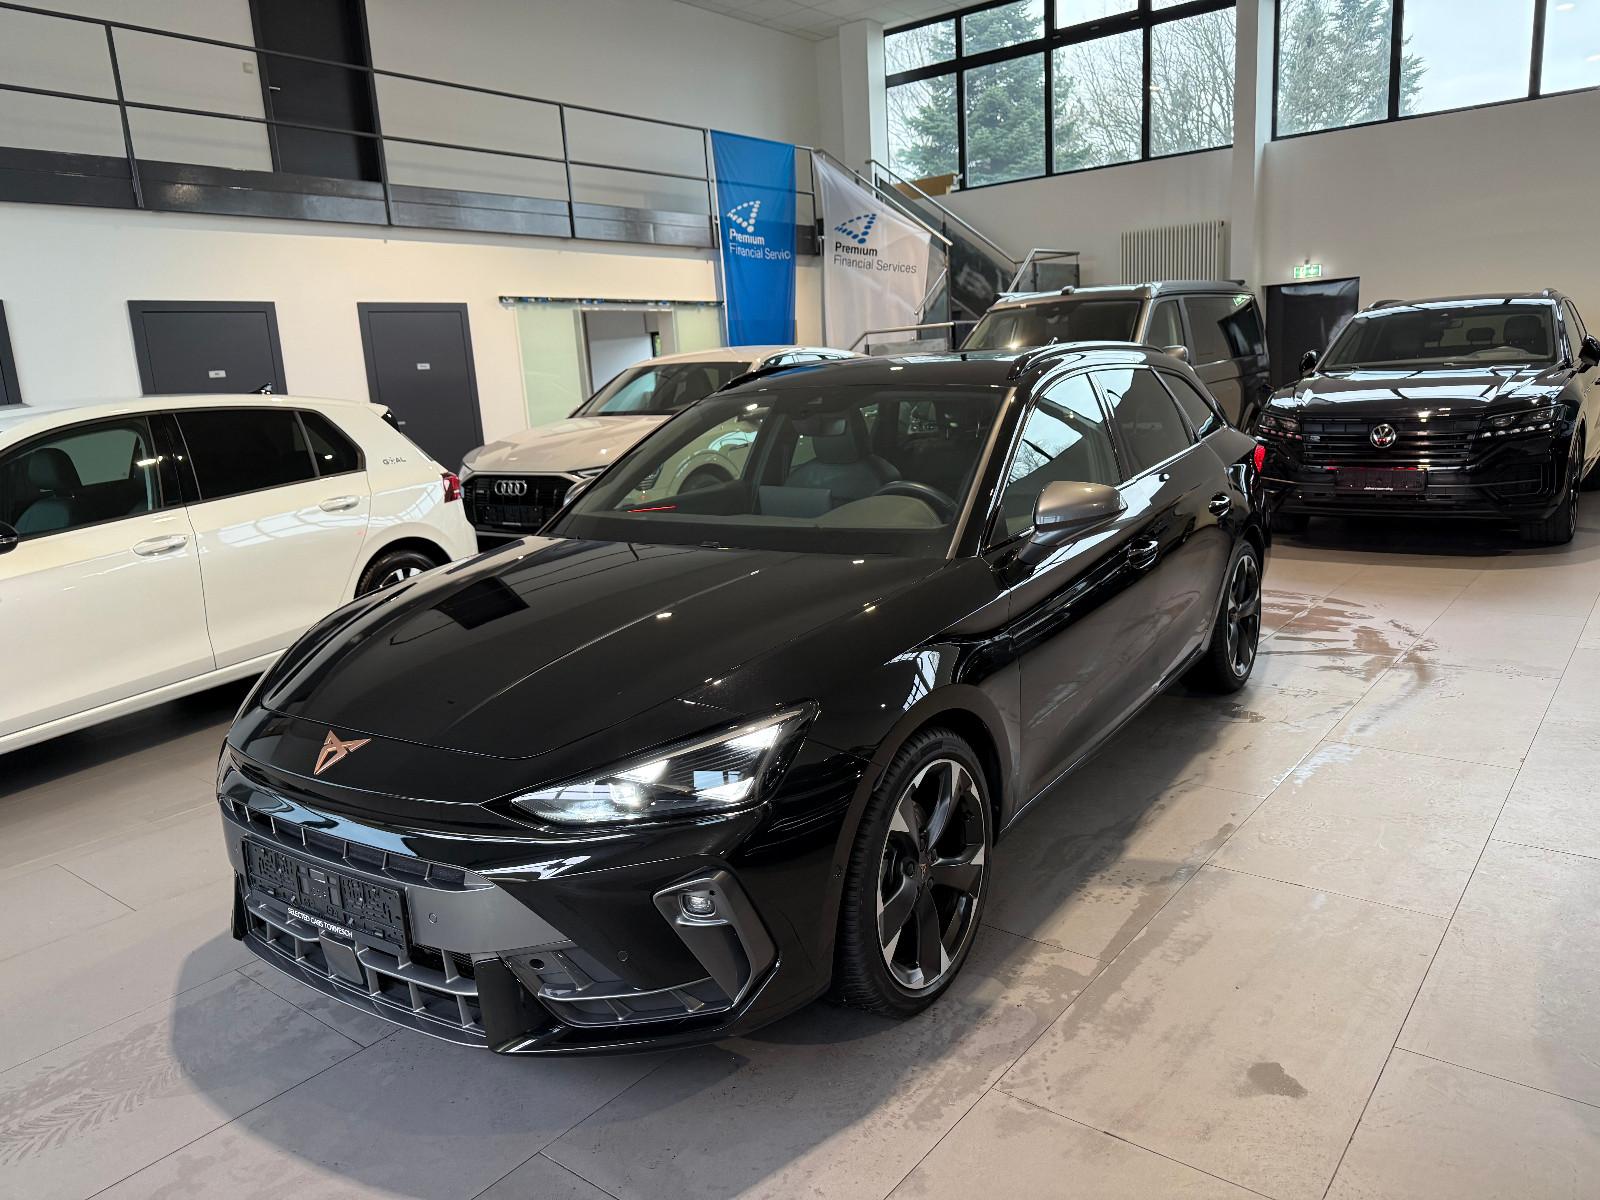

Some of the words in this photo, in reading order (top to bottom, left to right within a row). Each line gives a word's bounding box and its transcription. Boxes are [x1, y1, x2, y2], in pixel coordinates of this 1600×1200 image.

[729, 228, 765, 246] Premium
[729, 242, 763, 259] Financial
[835, 241, 878, 257] Premium
[834, 254, 874, 270] Financial
[876, 259, 917, 274] Services
[287, 907, 310, 922] SELECTED
